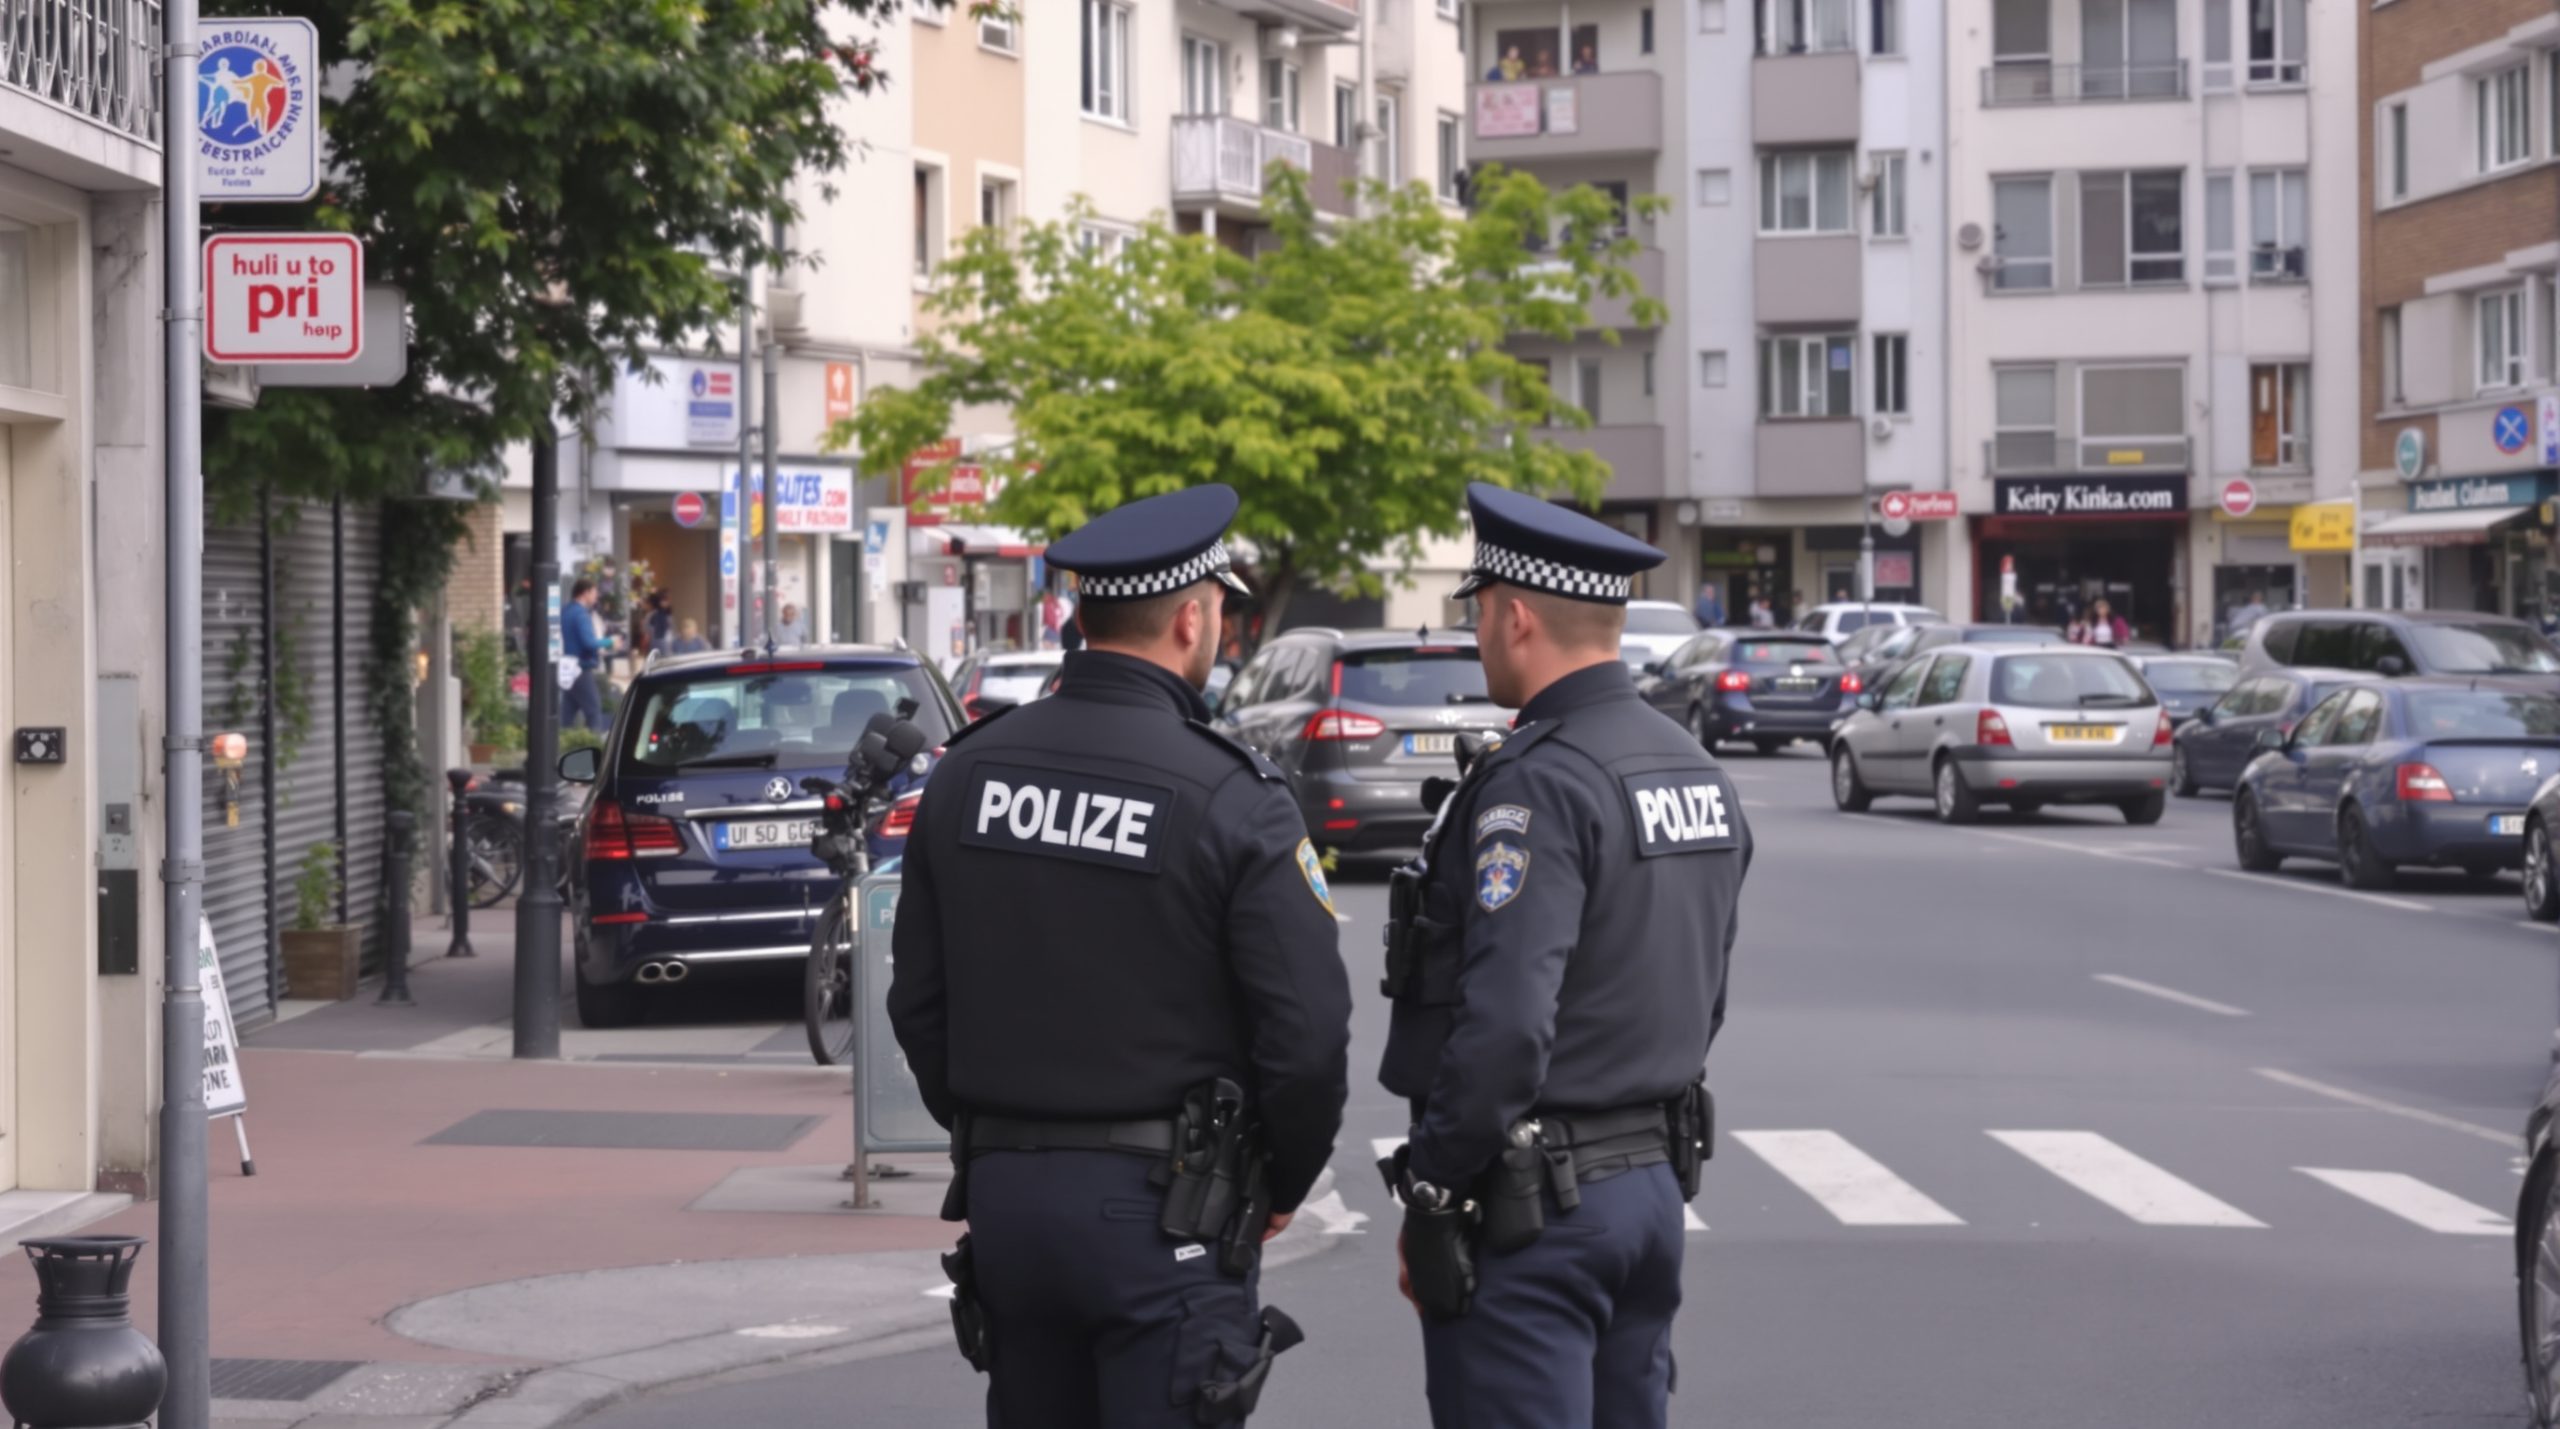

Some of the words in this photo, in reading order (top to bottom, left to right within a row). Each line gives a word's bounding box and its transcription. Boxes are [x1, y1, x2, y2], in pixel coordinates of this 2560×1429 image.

[232, 253, 278, 276] huli
[286, 260, 301, 276] u
[308, 255, 334, 276] to
[248, 277, 319, 333] pri
[976, 780, 1156, 858] POLIZE
[1635, 784, 1730, 843] POLIZE
